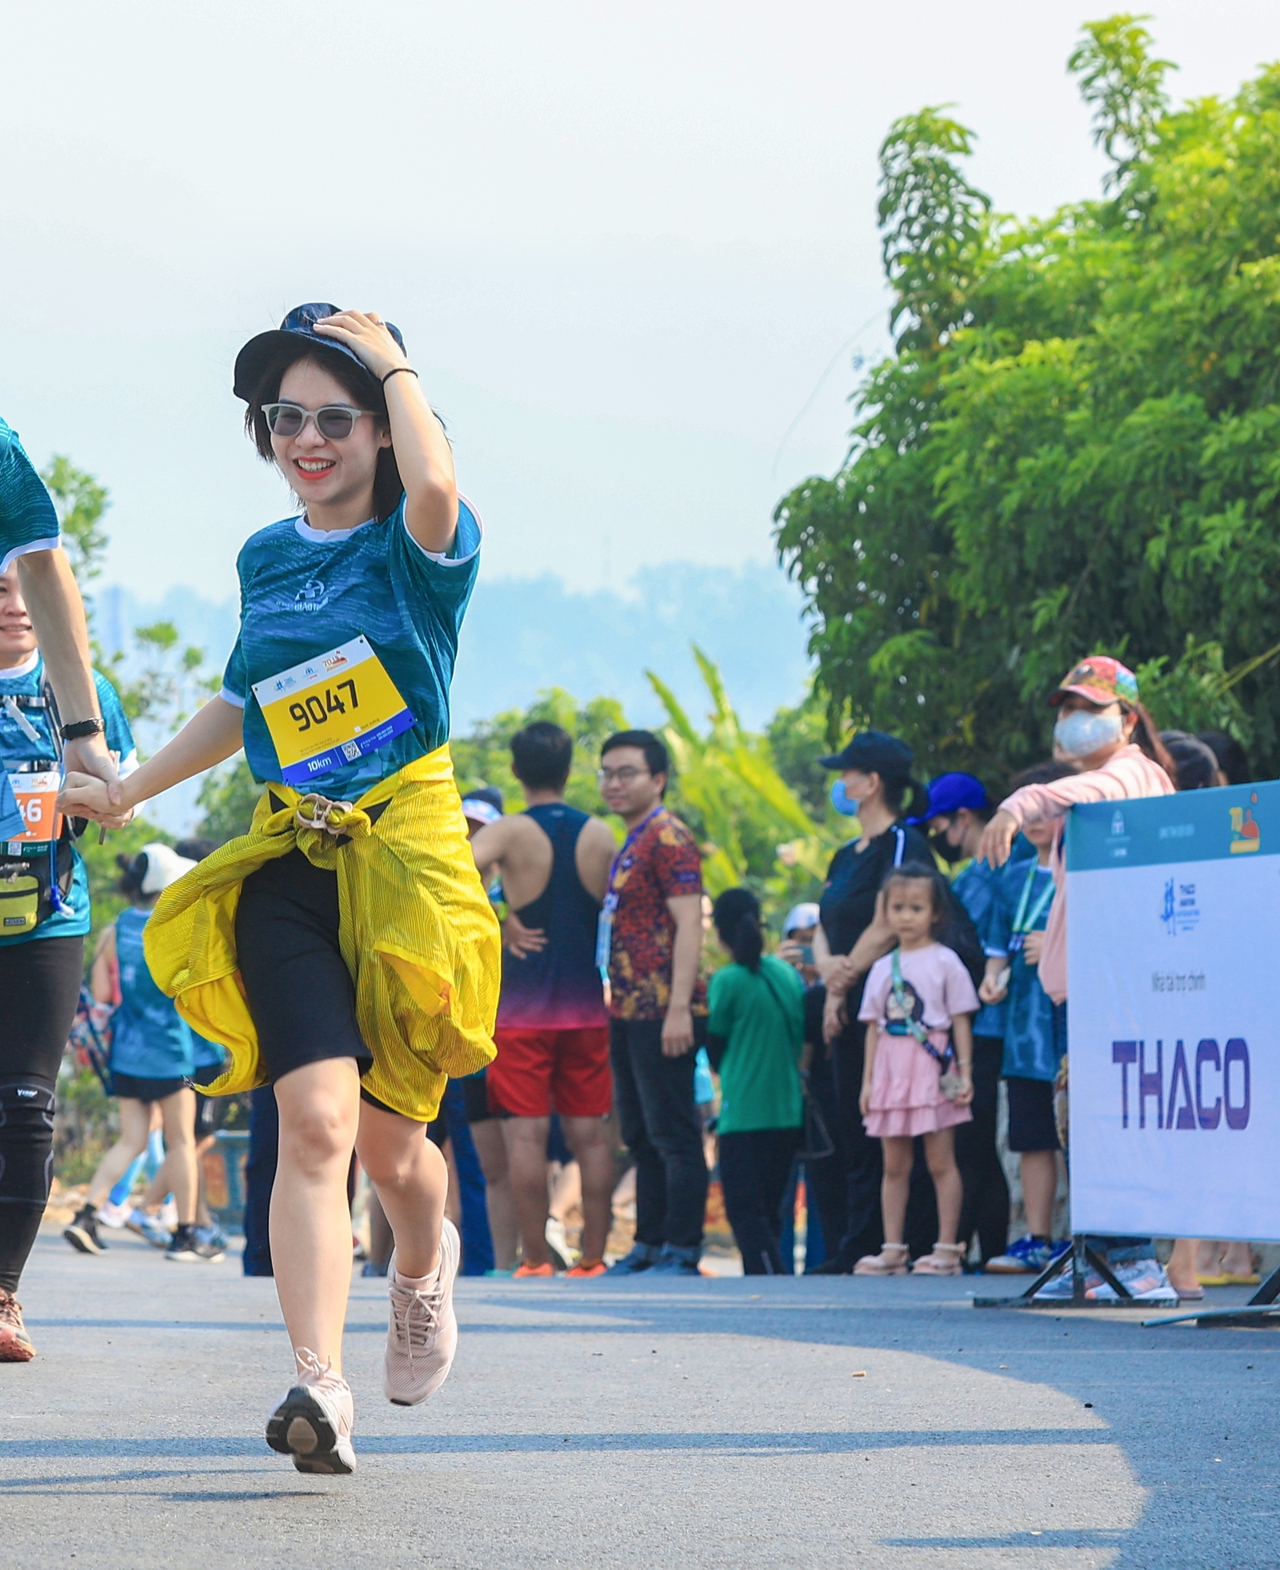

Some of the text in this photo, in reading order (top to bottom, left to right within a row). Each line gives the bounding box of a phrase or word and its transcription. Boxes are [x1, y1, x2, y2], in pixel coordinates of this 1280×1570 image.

[289, 679, 359, 732] 9047
[307, 756, 332, 772] 10km
[1112, 1038, 1251, 1130] THACO
